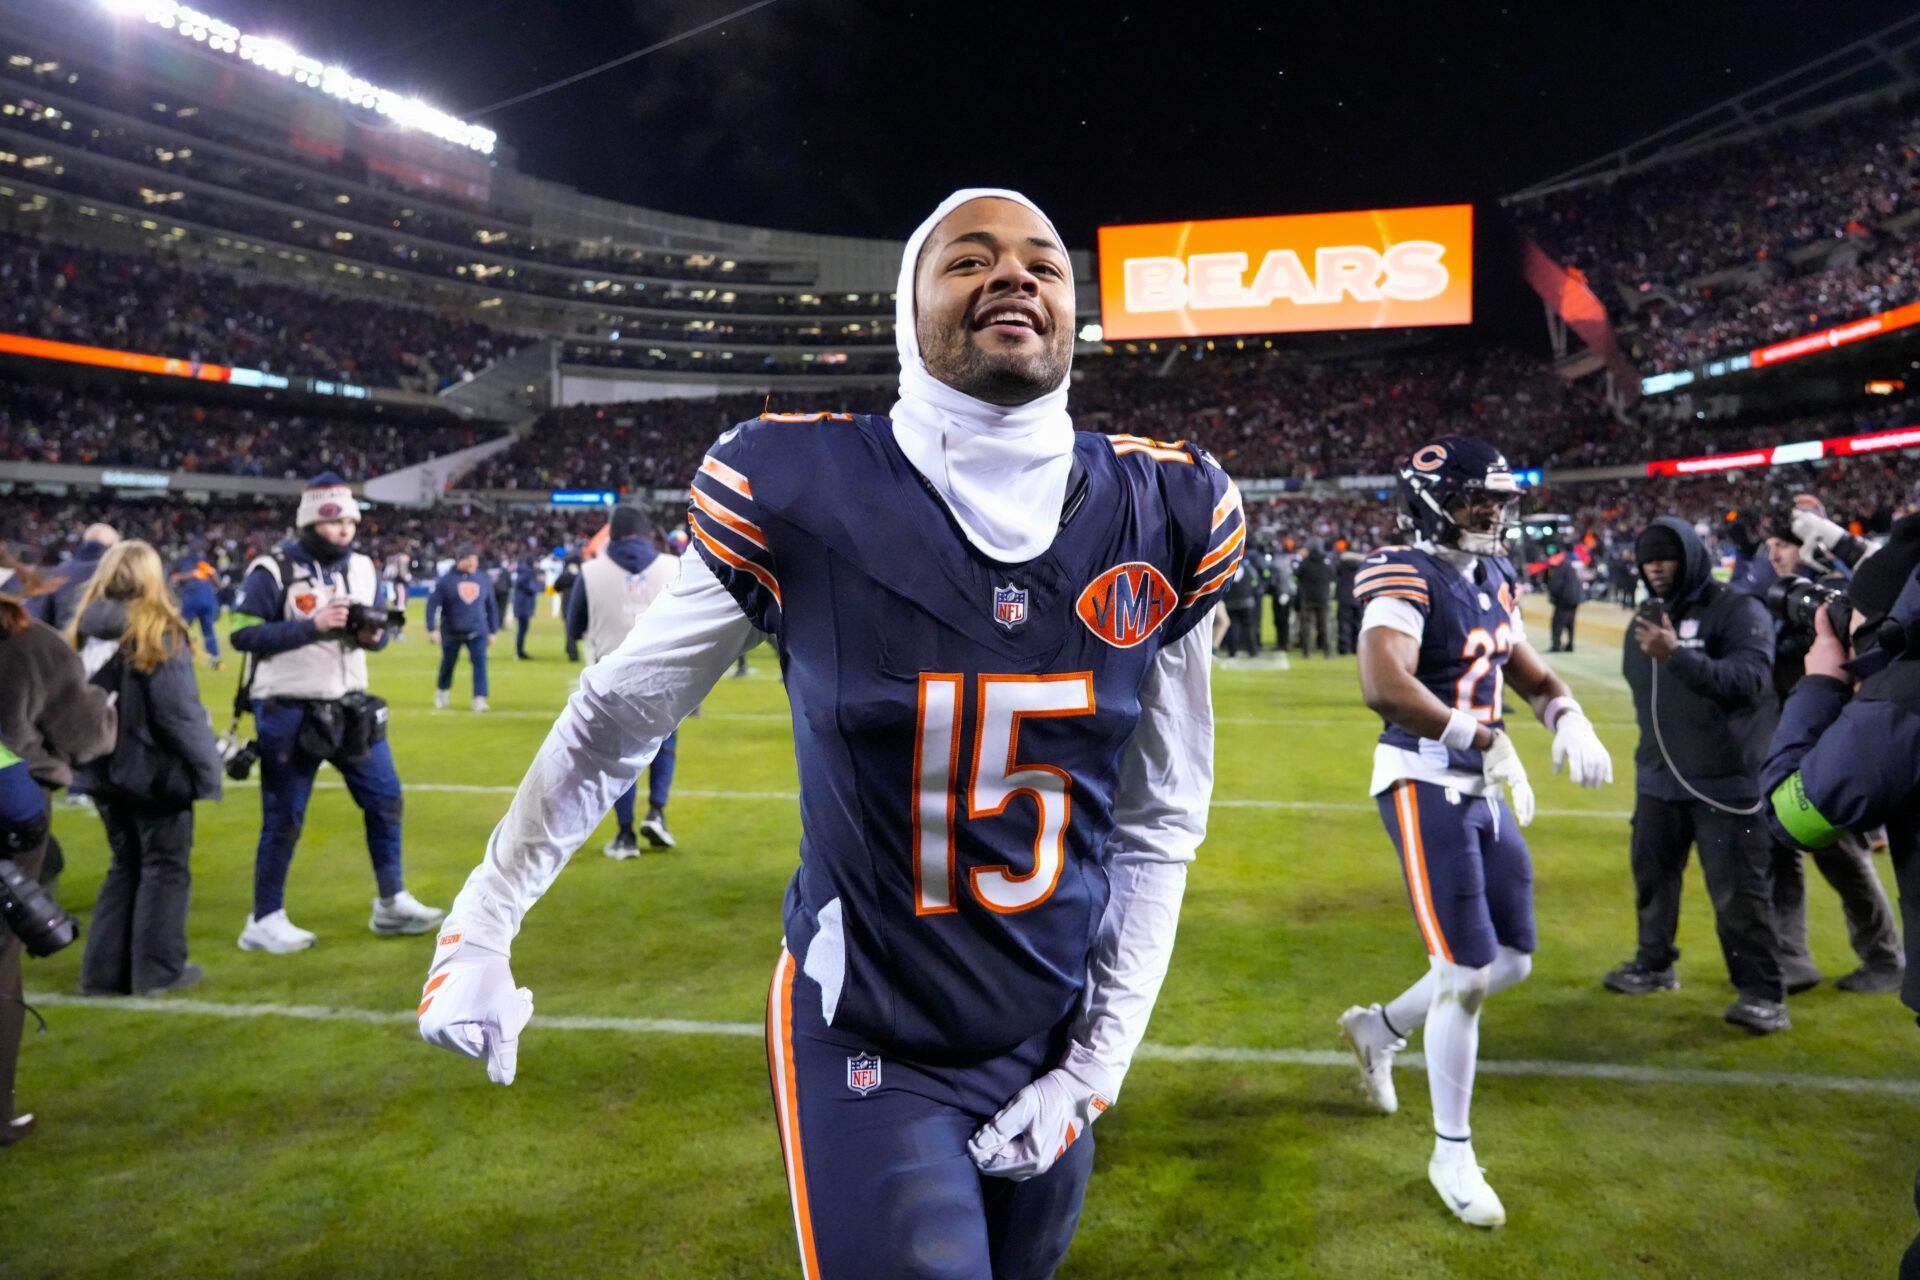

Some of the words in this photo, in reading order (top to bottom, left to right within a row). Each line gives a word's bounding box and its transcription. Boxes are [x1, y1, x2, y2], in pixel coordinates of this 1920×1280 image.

[1123, 240, 1449, 313] BEARS
[998, 604, 1023, 621] NFL
[1091, 569, 1166, 641] VMH
[911, 670, 1097, 917] 15
[852, 1070, 876, 1087] NFL
